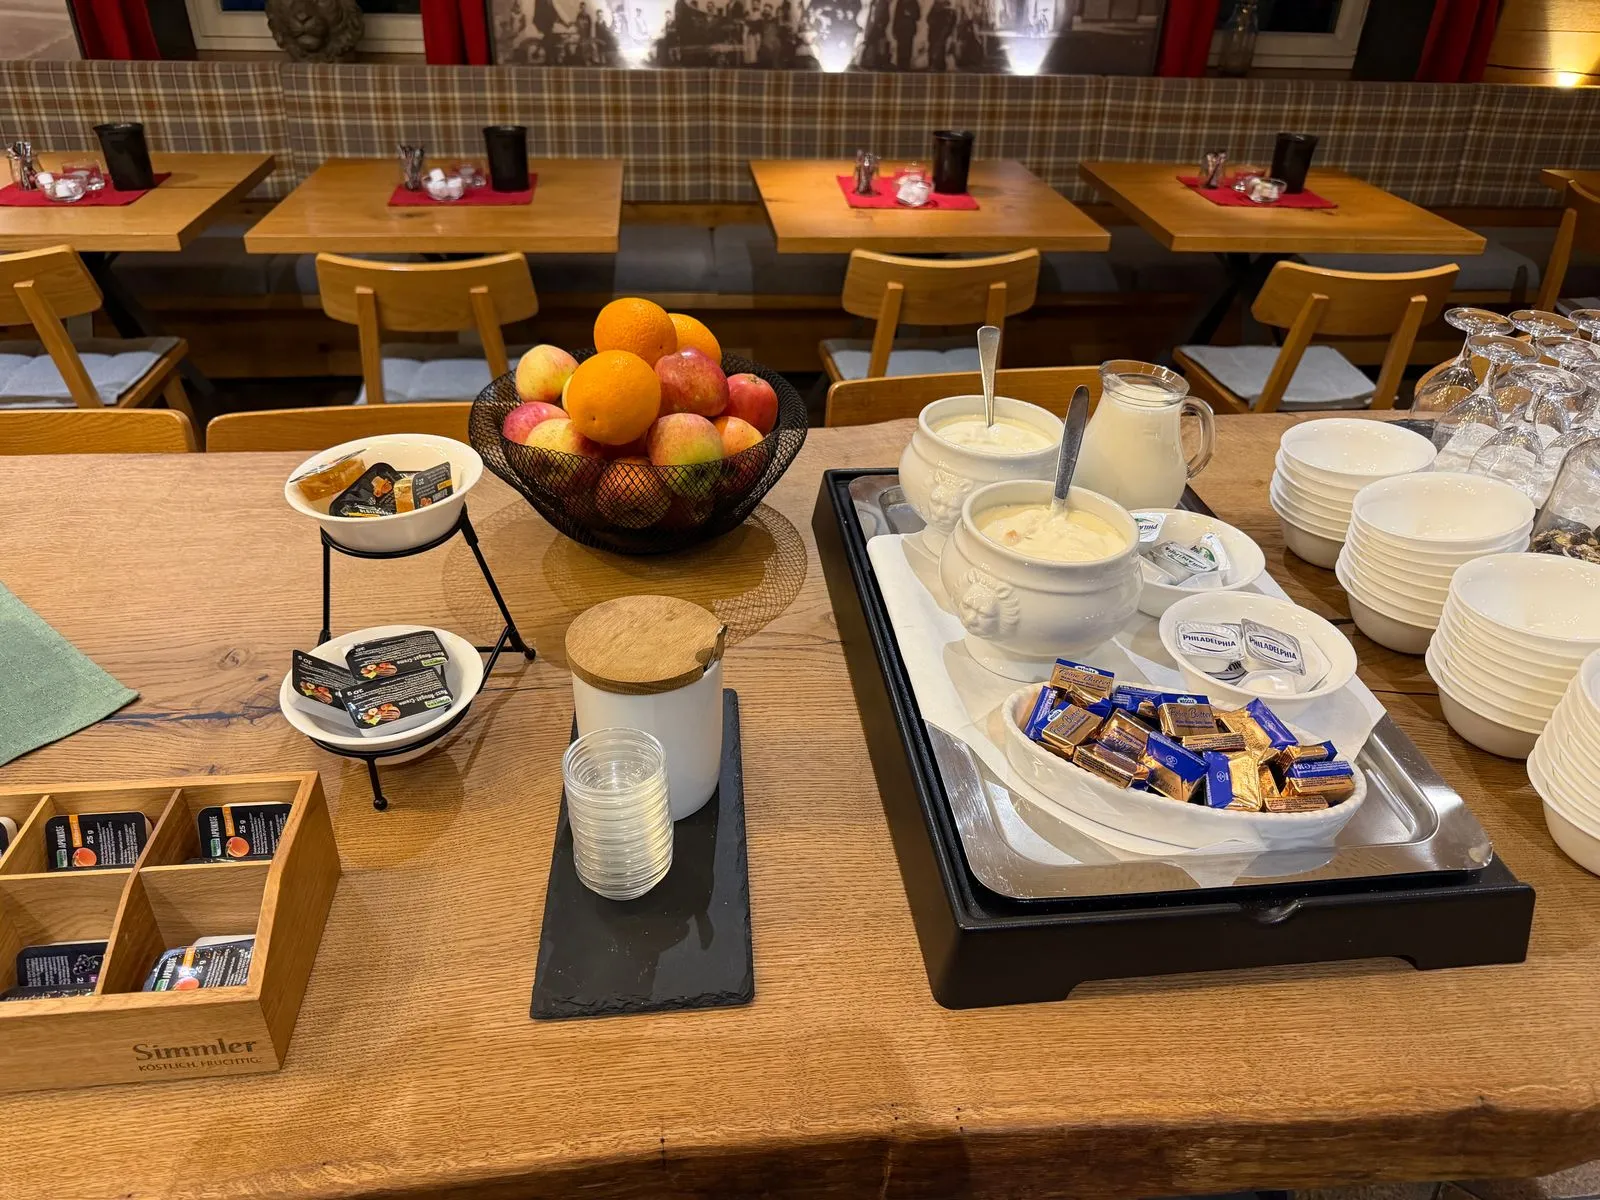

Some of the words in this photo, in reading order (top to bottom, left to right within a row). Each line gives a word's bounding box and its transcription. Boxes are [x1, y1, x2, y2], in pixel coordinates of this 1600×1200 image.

[1182, 634, 1236, 647] PHILADELPHIA
[1248, 635, 1297, 660] PHILADELPHIA
[56, 825, 66, 848] APRIKOSE
[209, 815, 220, 837] APRIKOSE
[239, 825, 246, 834] 25
[87, 836, 94, 844] 25
[132, 1038, 257, 1061] Simmler
